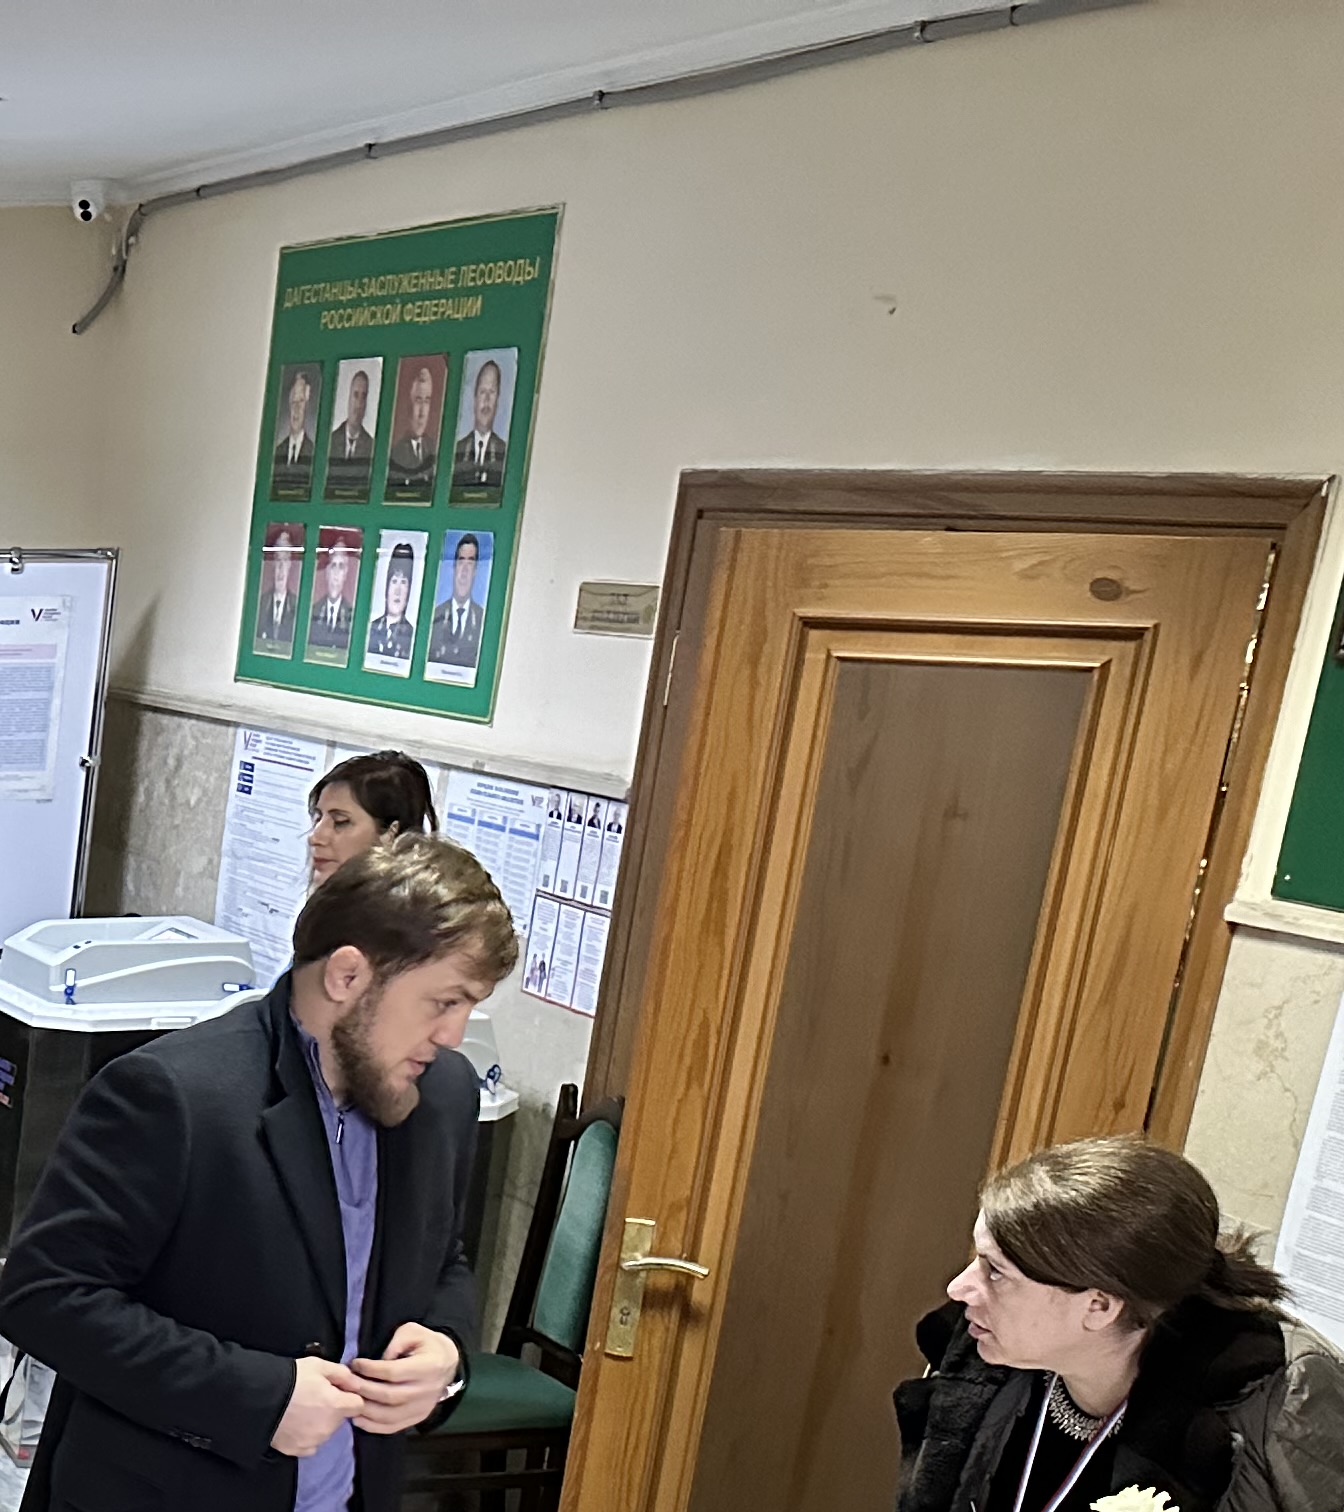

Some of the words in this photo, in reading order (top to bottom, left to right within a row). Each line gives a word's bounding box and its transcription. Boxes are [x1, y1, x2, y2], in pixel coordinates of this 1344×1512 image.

[283, 266, 455, 308] ДАГЕСТАНЦЫ-ЗАСЛУЖЕННЫЕ
[459, 257, 539, 287] ЛЕСОВОДЫ
[320, 301, 401, 331] РОССИЙСКОЙ
[403, 295, 481, 324] ФЕДЕРАЦИИ
